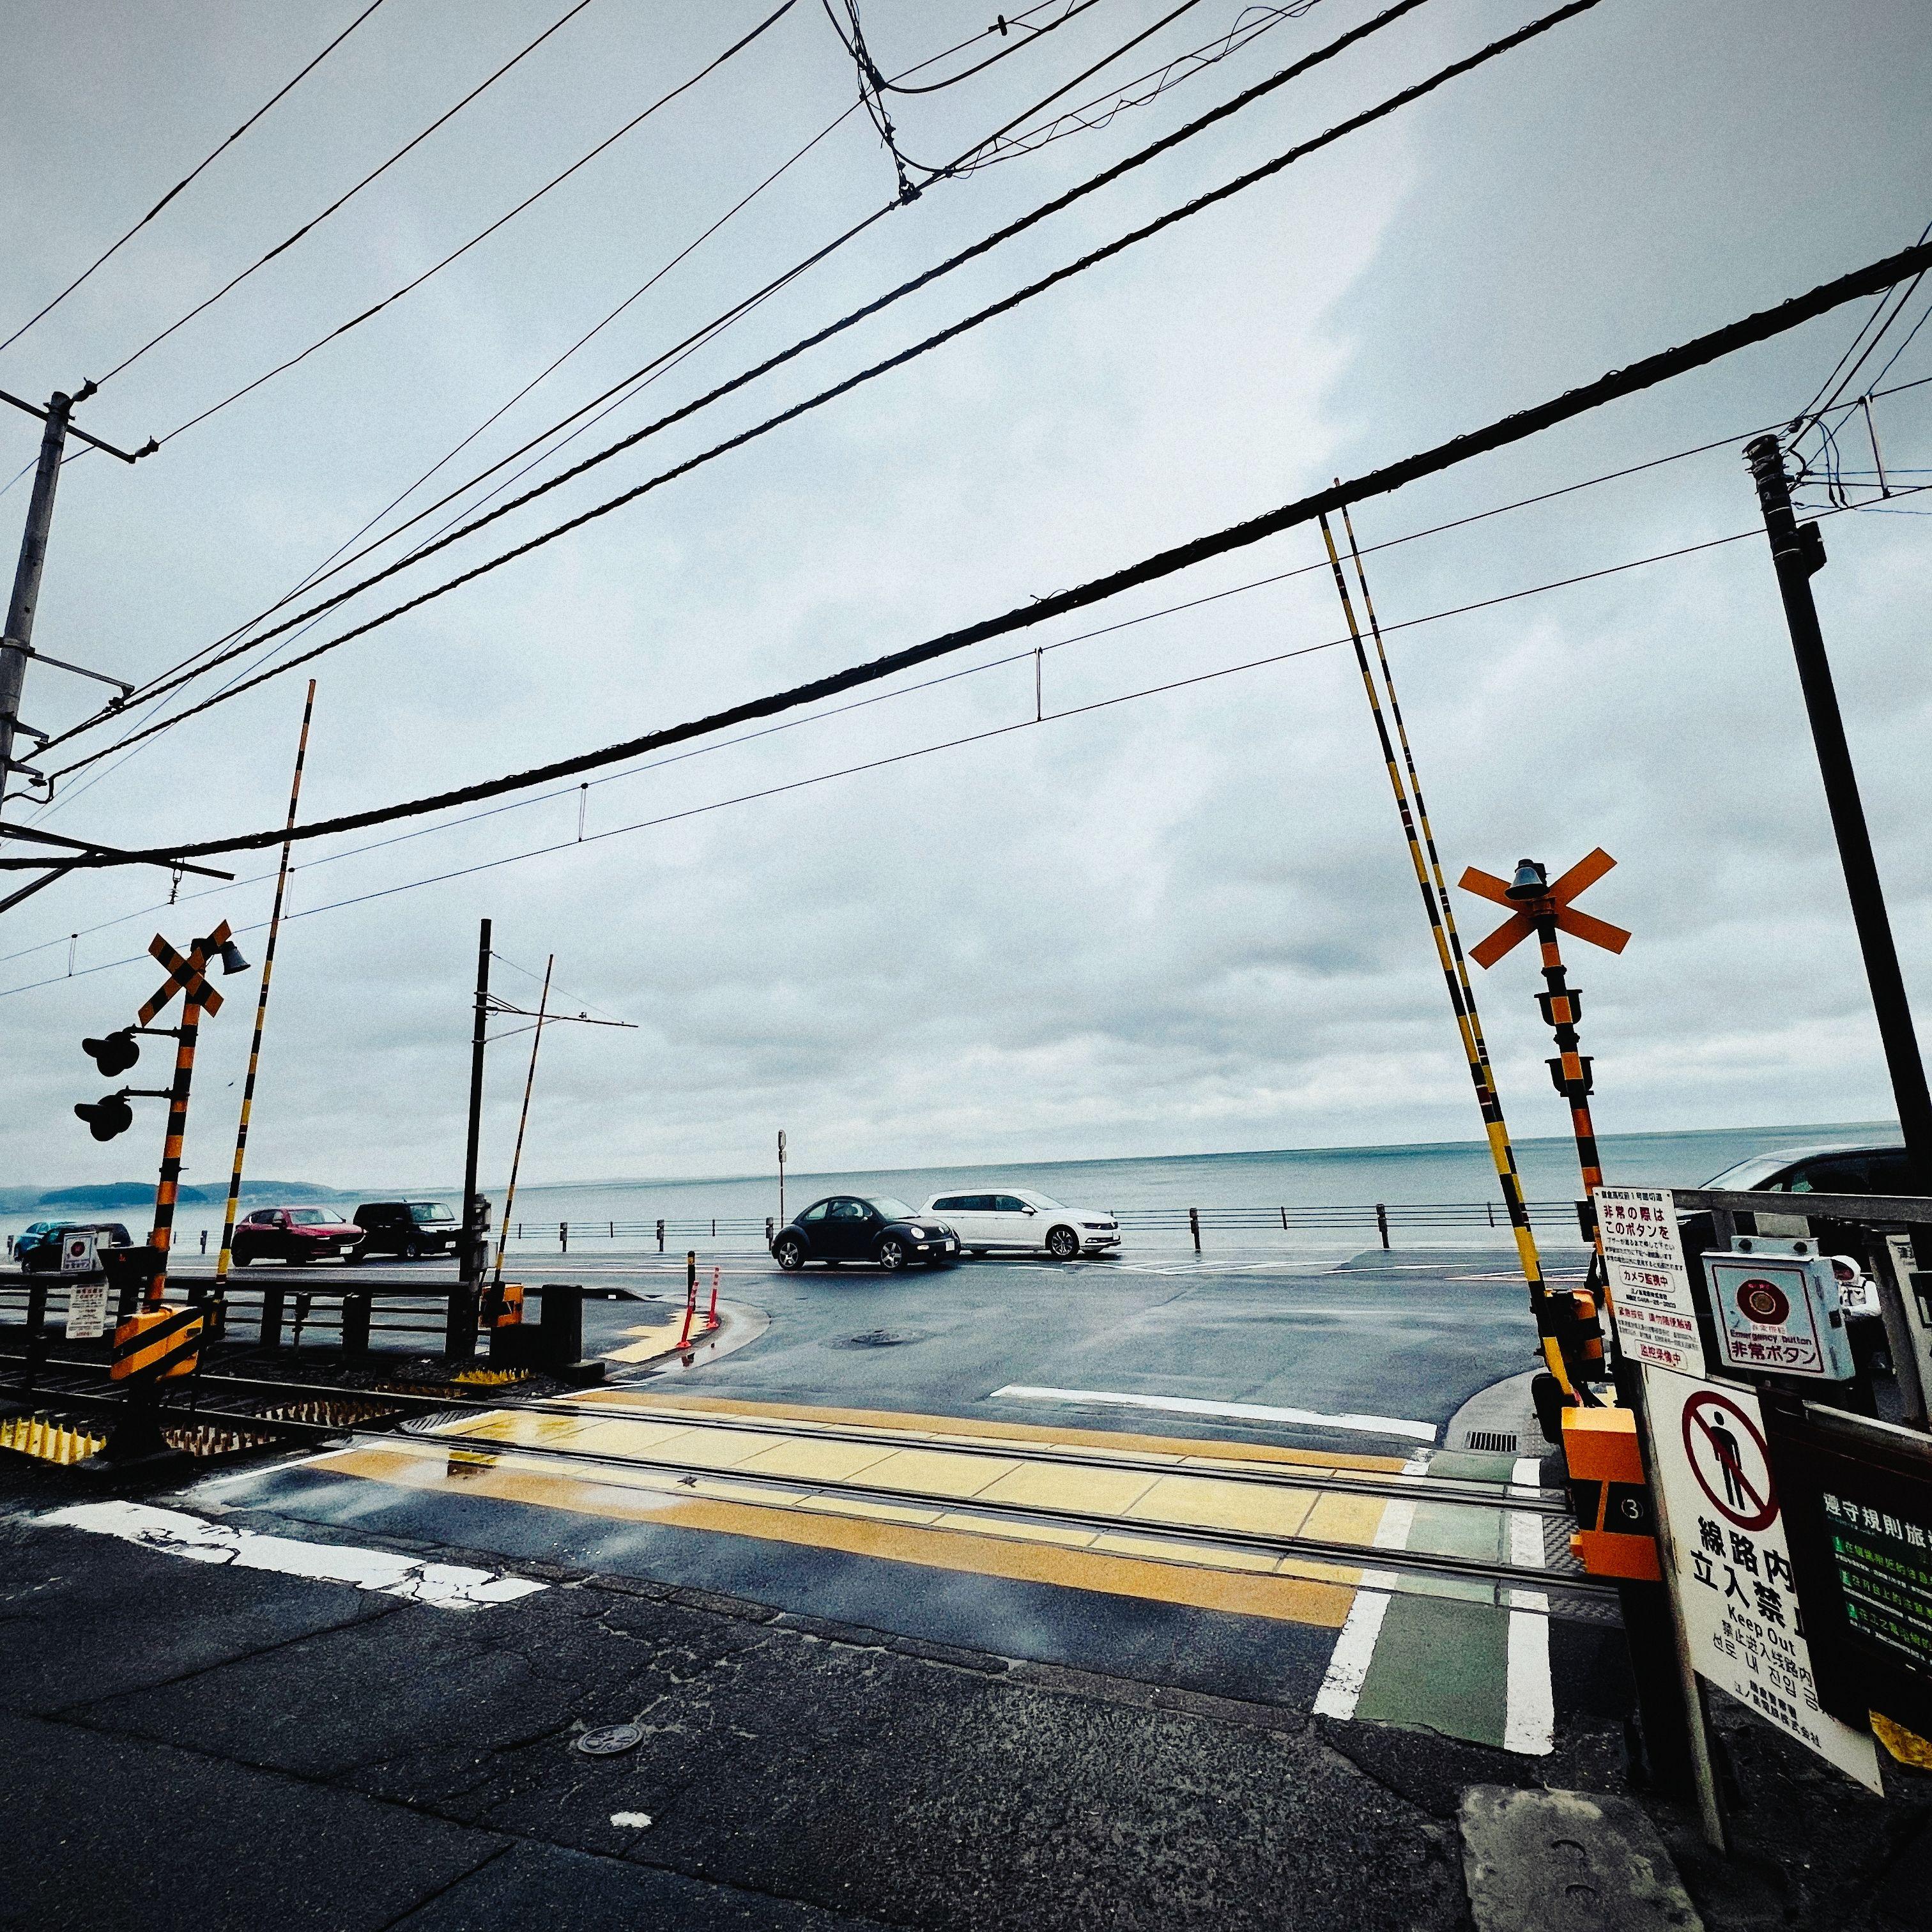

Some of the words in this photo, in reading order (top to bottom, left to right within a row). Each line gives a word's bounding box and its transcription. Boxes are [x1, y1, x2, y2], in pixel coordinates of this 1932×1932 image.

[1604, 1204, 1665, 1222] 非常の際は
[1605, 1221, 1670, 1240] このボタンを
[1624, 1270, 1668, 1287] カメラ監視中
[1729, 1330, 1777, 1344] Emergency
[1781, 1335, 1812, 1346] button
[1731, 1340, 1816, 1365] 非常ボタン
[1823, 1492, 1932, 1551] 遵守規則旅
[1697, 1515, 1797, 1594] 線路内
[1727, 1604, 1763, 1638] Keep
[1767, 1627, 1797, 1657] Out
[1713, 1632, 1738, 1660] 선로
[1745, 1652, 1759, 1675] 내
[1767, 1665, 1797, 1698] 진입
[1803, 1687, 1821, 1712] 금
